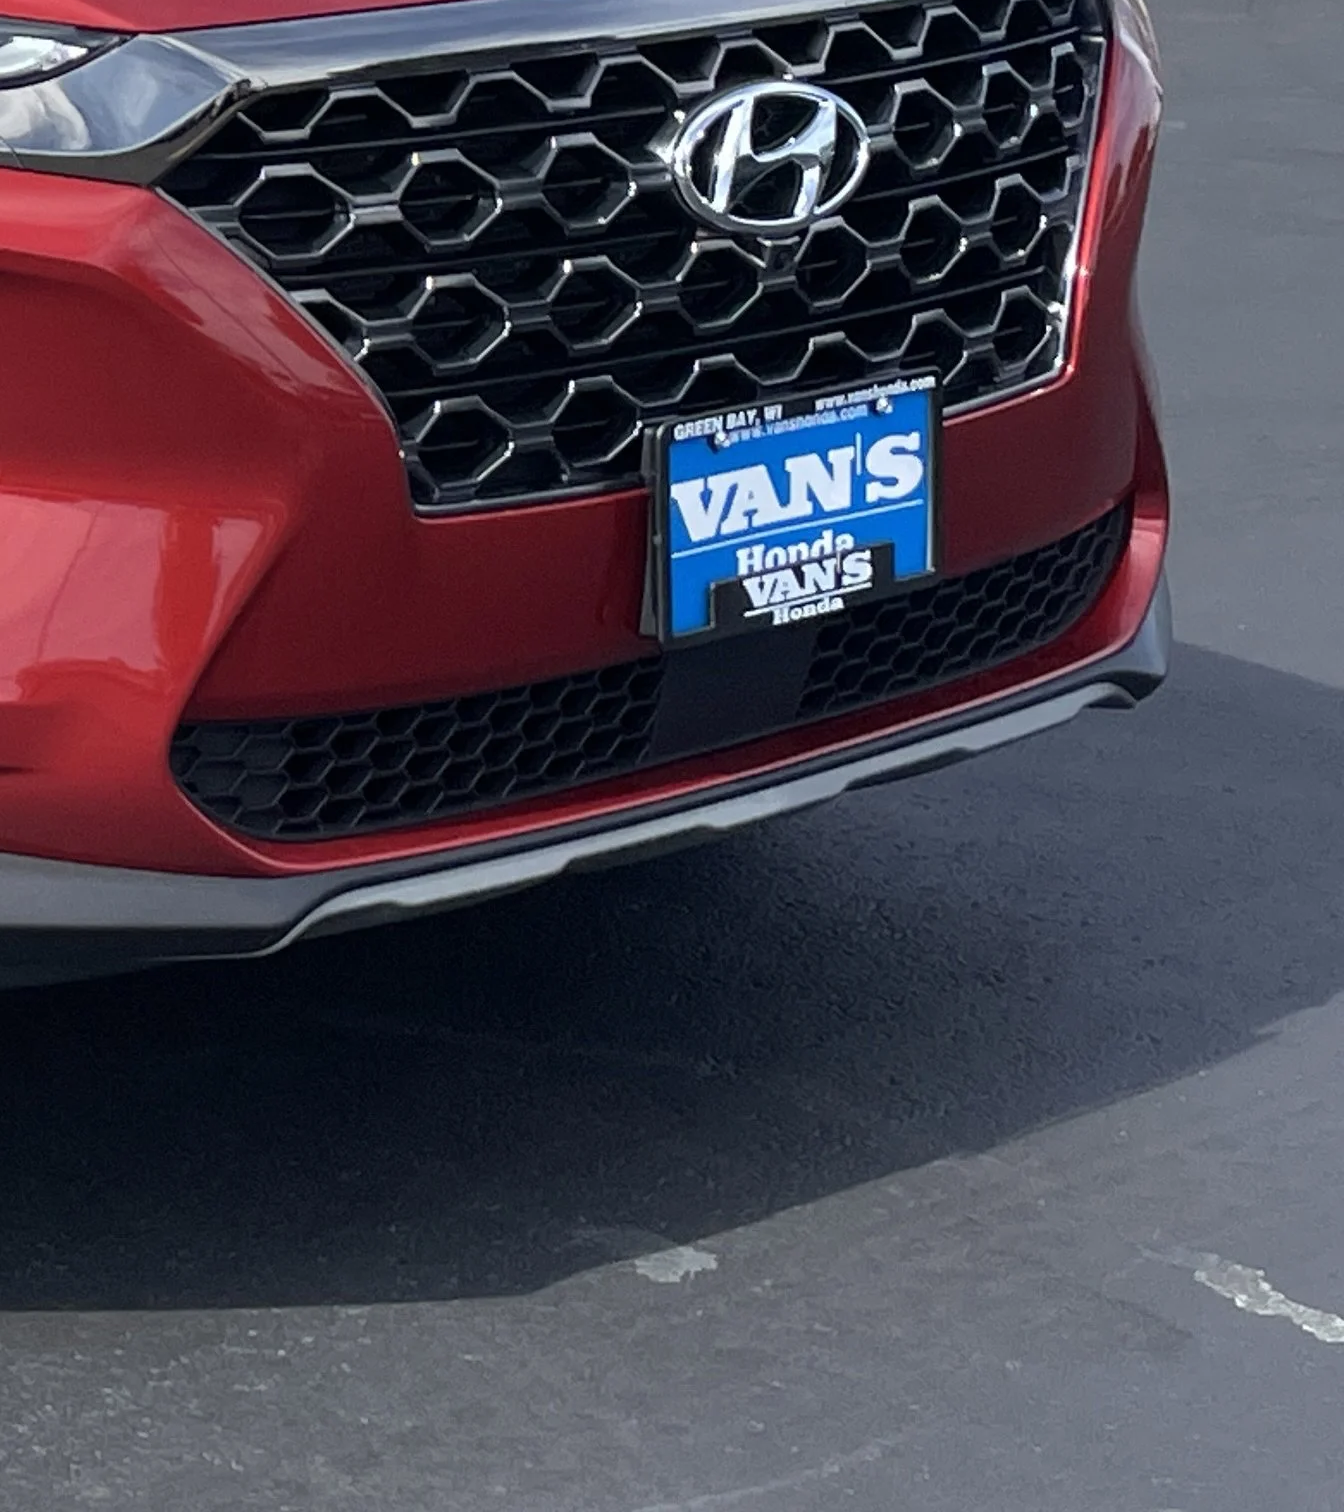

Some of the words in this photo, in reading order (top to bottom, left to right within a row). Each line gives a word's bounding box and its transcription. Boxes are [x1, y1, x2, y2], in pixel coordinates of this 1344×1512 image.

[673, 414, 724, 441] GREEN
[670, 431, 924, 543] VAN'S
[736, 529, 855, 576] Honda
[742, 549, 872, 608] VAN'S
[771, 594, 845, 626] Honda
